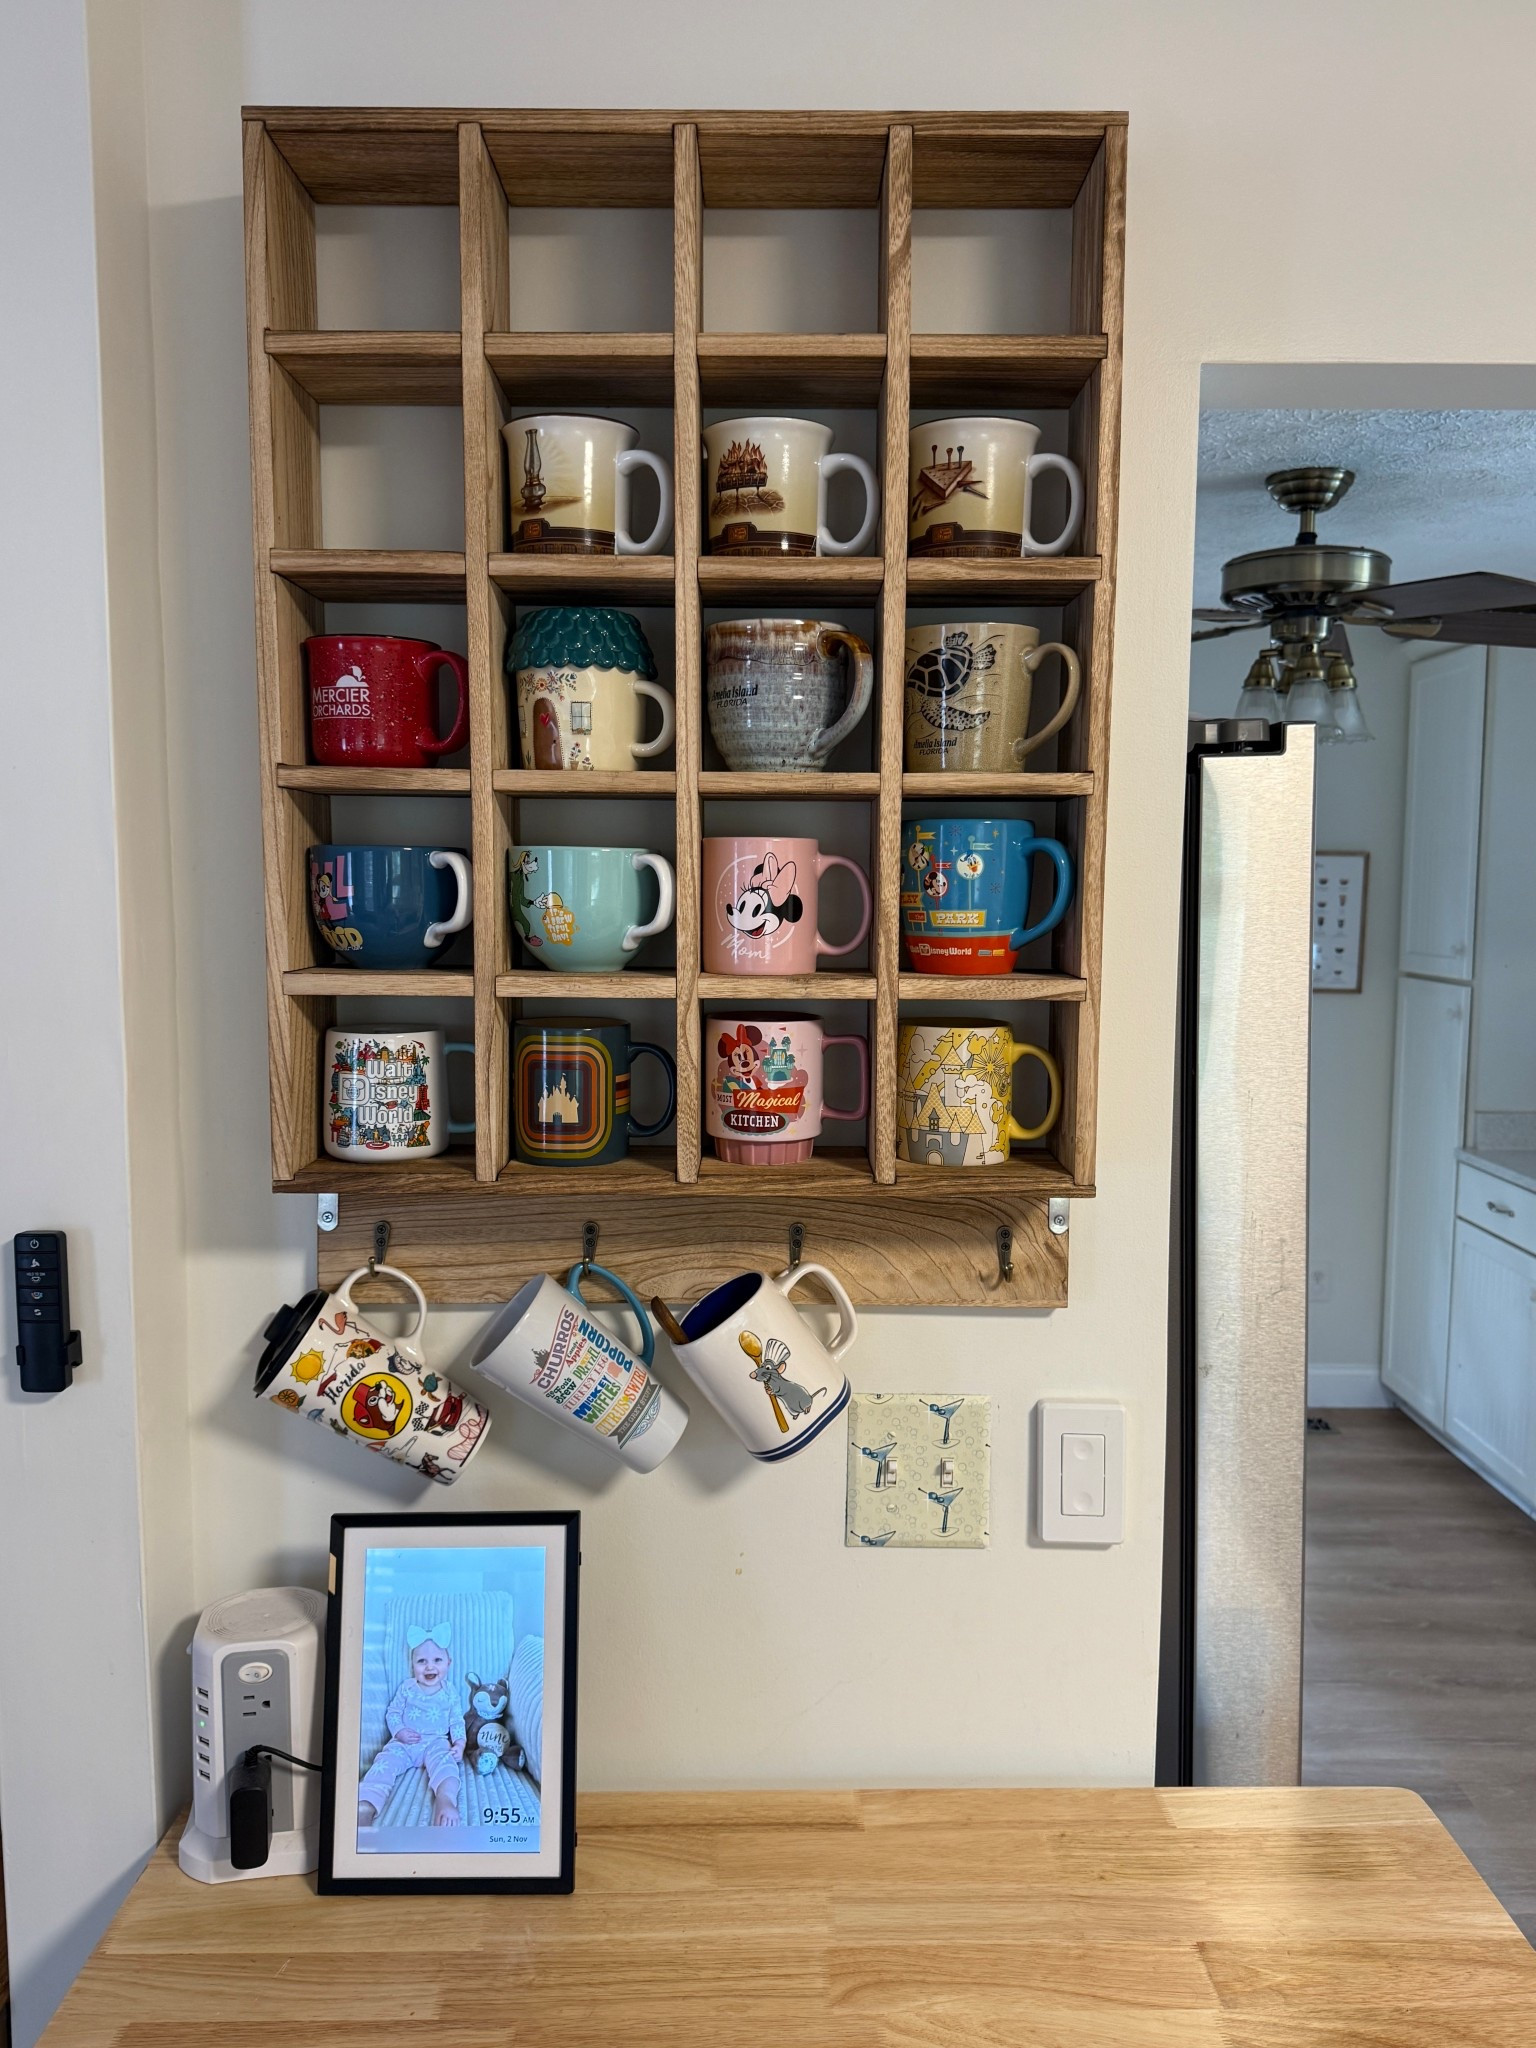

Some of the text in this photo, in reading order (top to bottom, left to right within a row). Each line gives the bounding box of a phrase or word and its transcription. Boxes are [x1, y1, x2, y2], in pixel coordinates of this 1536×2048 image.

[312, 687, 370, 703] MERCIER
[716, 698, 748, 709] FLORIDA
[313, 704, 371, 716] ORCHARDS
[935, 912, 980, 924] PARK
[366, 1059, 413, 1079] Walt
[338, 1072, 418, 1105] Disney
[716, 1091, 800, 1109] MOST Magical
[358, 1104, 415, 1125] World
[730, 1113, 779, 1128] KITCHEN
[537, 1309, 575, 1389] CHURROS
[565, 1337, 587, 1367] Apples
[578, 1318, 634, 1373] POPCORN
[573, 1346, 600, 1380] PRETZEL
[323, 1360, 367, 1405] Florida
[553, 1381, 577, 1404] Brew
[563, 1376, 596, 1410] TURKEY
[593, 1355, 609, 1375] LEG
[572, 1375, 612, 1419] MICKEY
[583, 1382, 621, 1423] WAFFLES
[595, 1366, 647, 1436] CITRUS SWIRL
[618, 1386, 652, 1434] THE GREY STUFF
[480, 1731, 509, 1745] nine
[483, 1807, 521, 1824] 9:55
[489, 1835, 506, 1843] Sun,
